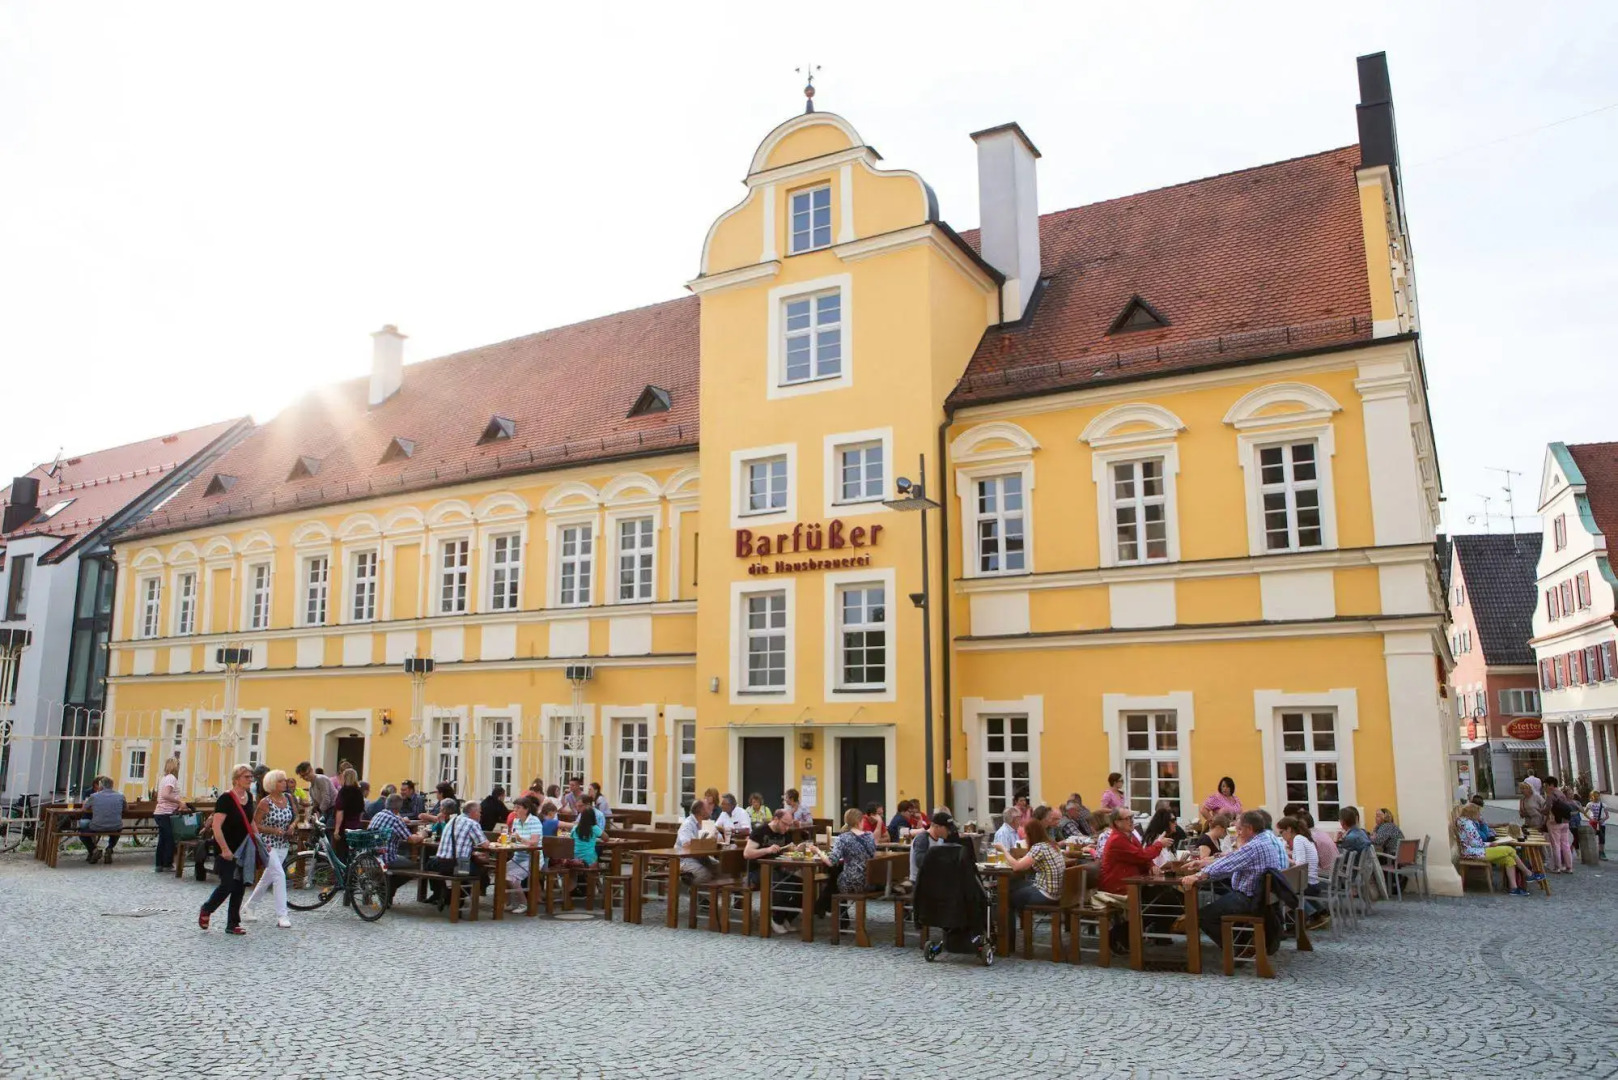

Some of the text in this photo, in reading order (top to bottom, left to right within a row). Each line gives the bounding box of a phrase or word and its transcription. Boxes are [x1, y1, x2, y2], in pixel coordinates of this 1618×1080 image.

[736, 519, 883, 558] Barfüßer
[748, 553, 870, 575] die Hausbrauerei
[805, 757, 812, 770] 6
